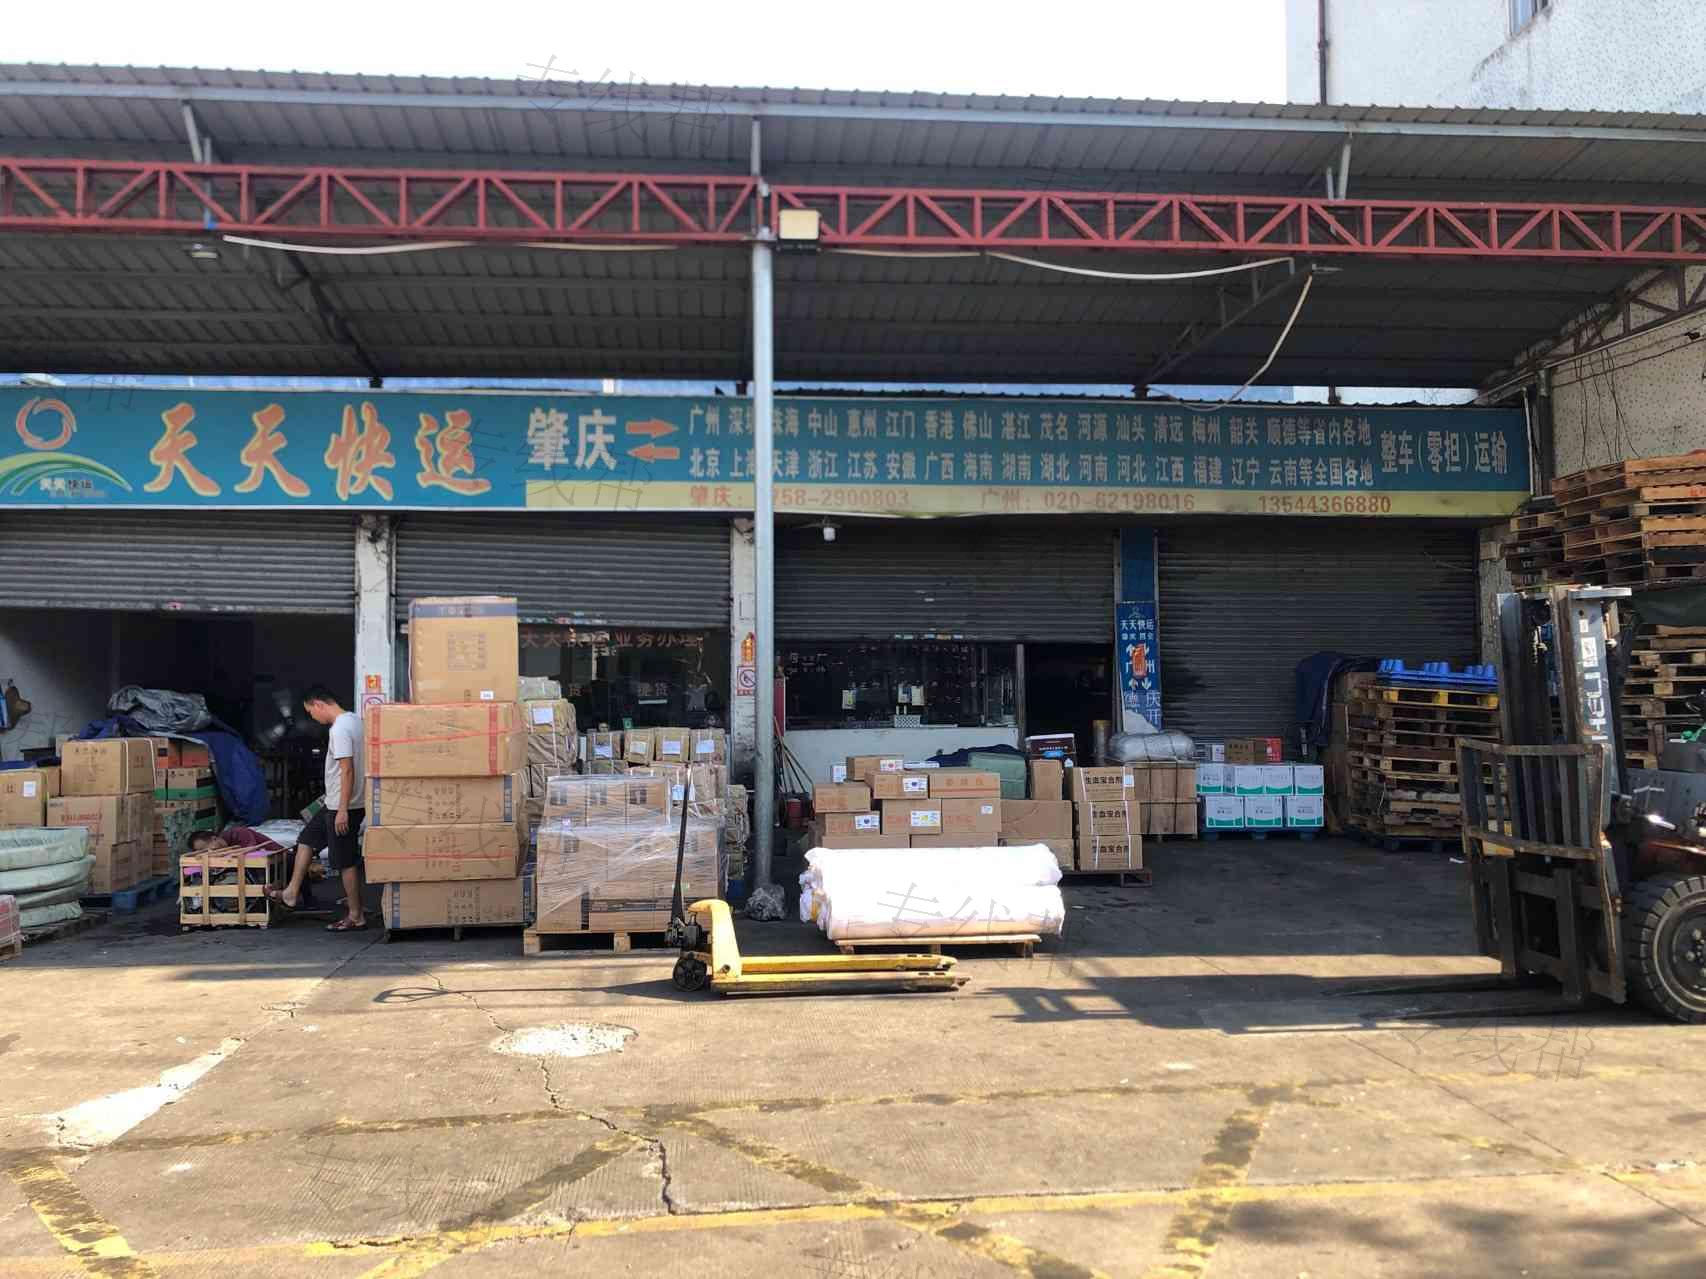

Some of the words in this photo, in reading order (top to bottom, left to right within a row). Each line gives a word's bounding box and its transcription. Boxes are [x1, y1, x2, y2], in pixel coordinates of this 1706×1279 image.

[527, 407, 617, 471] 肇庆
[689, 404, 720, 436] 广州
[808, 406, 837, 438] 中山
[847, 407, 877, 439] 惠州
[886, 407, 916, 439] 江门
[924, 408, 953, 440] 香港
[963, 409, 992, 440] 佛山
[1001, 409, 1031, 441] 湛江
[1040, 410, 1068, 442] 茂名
[1116, 411, 1145, 443] 汕头
[1154, 412, 1184, 443] 清远
[1192, 413, 1220, 444] 梅州
[144, 401, 492, 500] 天天快运
[689, 448, 720, 477] 北京
[808, 450, 838, 479] 浙江
[847, 450, 877, 480] 江苏
[886, 451, 916, 480] 安徽
[924, 451, 954, 481] 广西
[963, 452, 993, 481] 海南
[1002, 453, 1032, 482] 湖南
[1040, 453, 1070, 483] 湖北
[1079, 454, 1108, 483] 河南
[1117, 454, 1147, 484] 河北
[1155, 455, 1185, 484] 江西
[1193, 455, 1223, 485] 福建
[1231, 456, 1260, 485] 辽宁
[1269, 456, 1374, 487] 云南等全国各地
[1258, 496, 1392, 513] 13544366880
